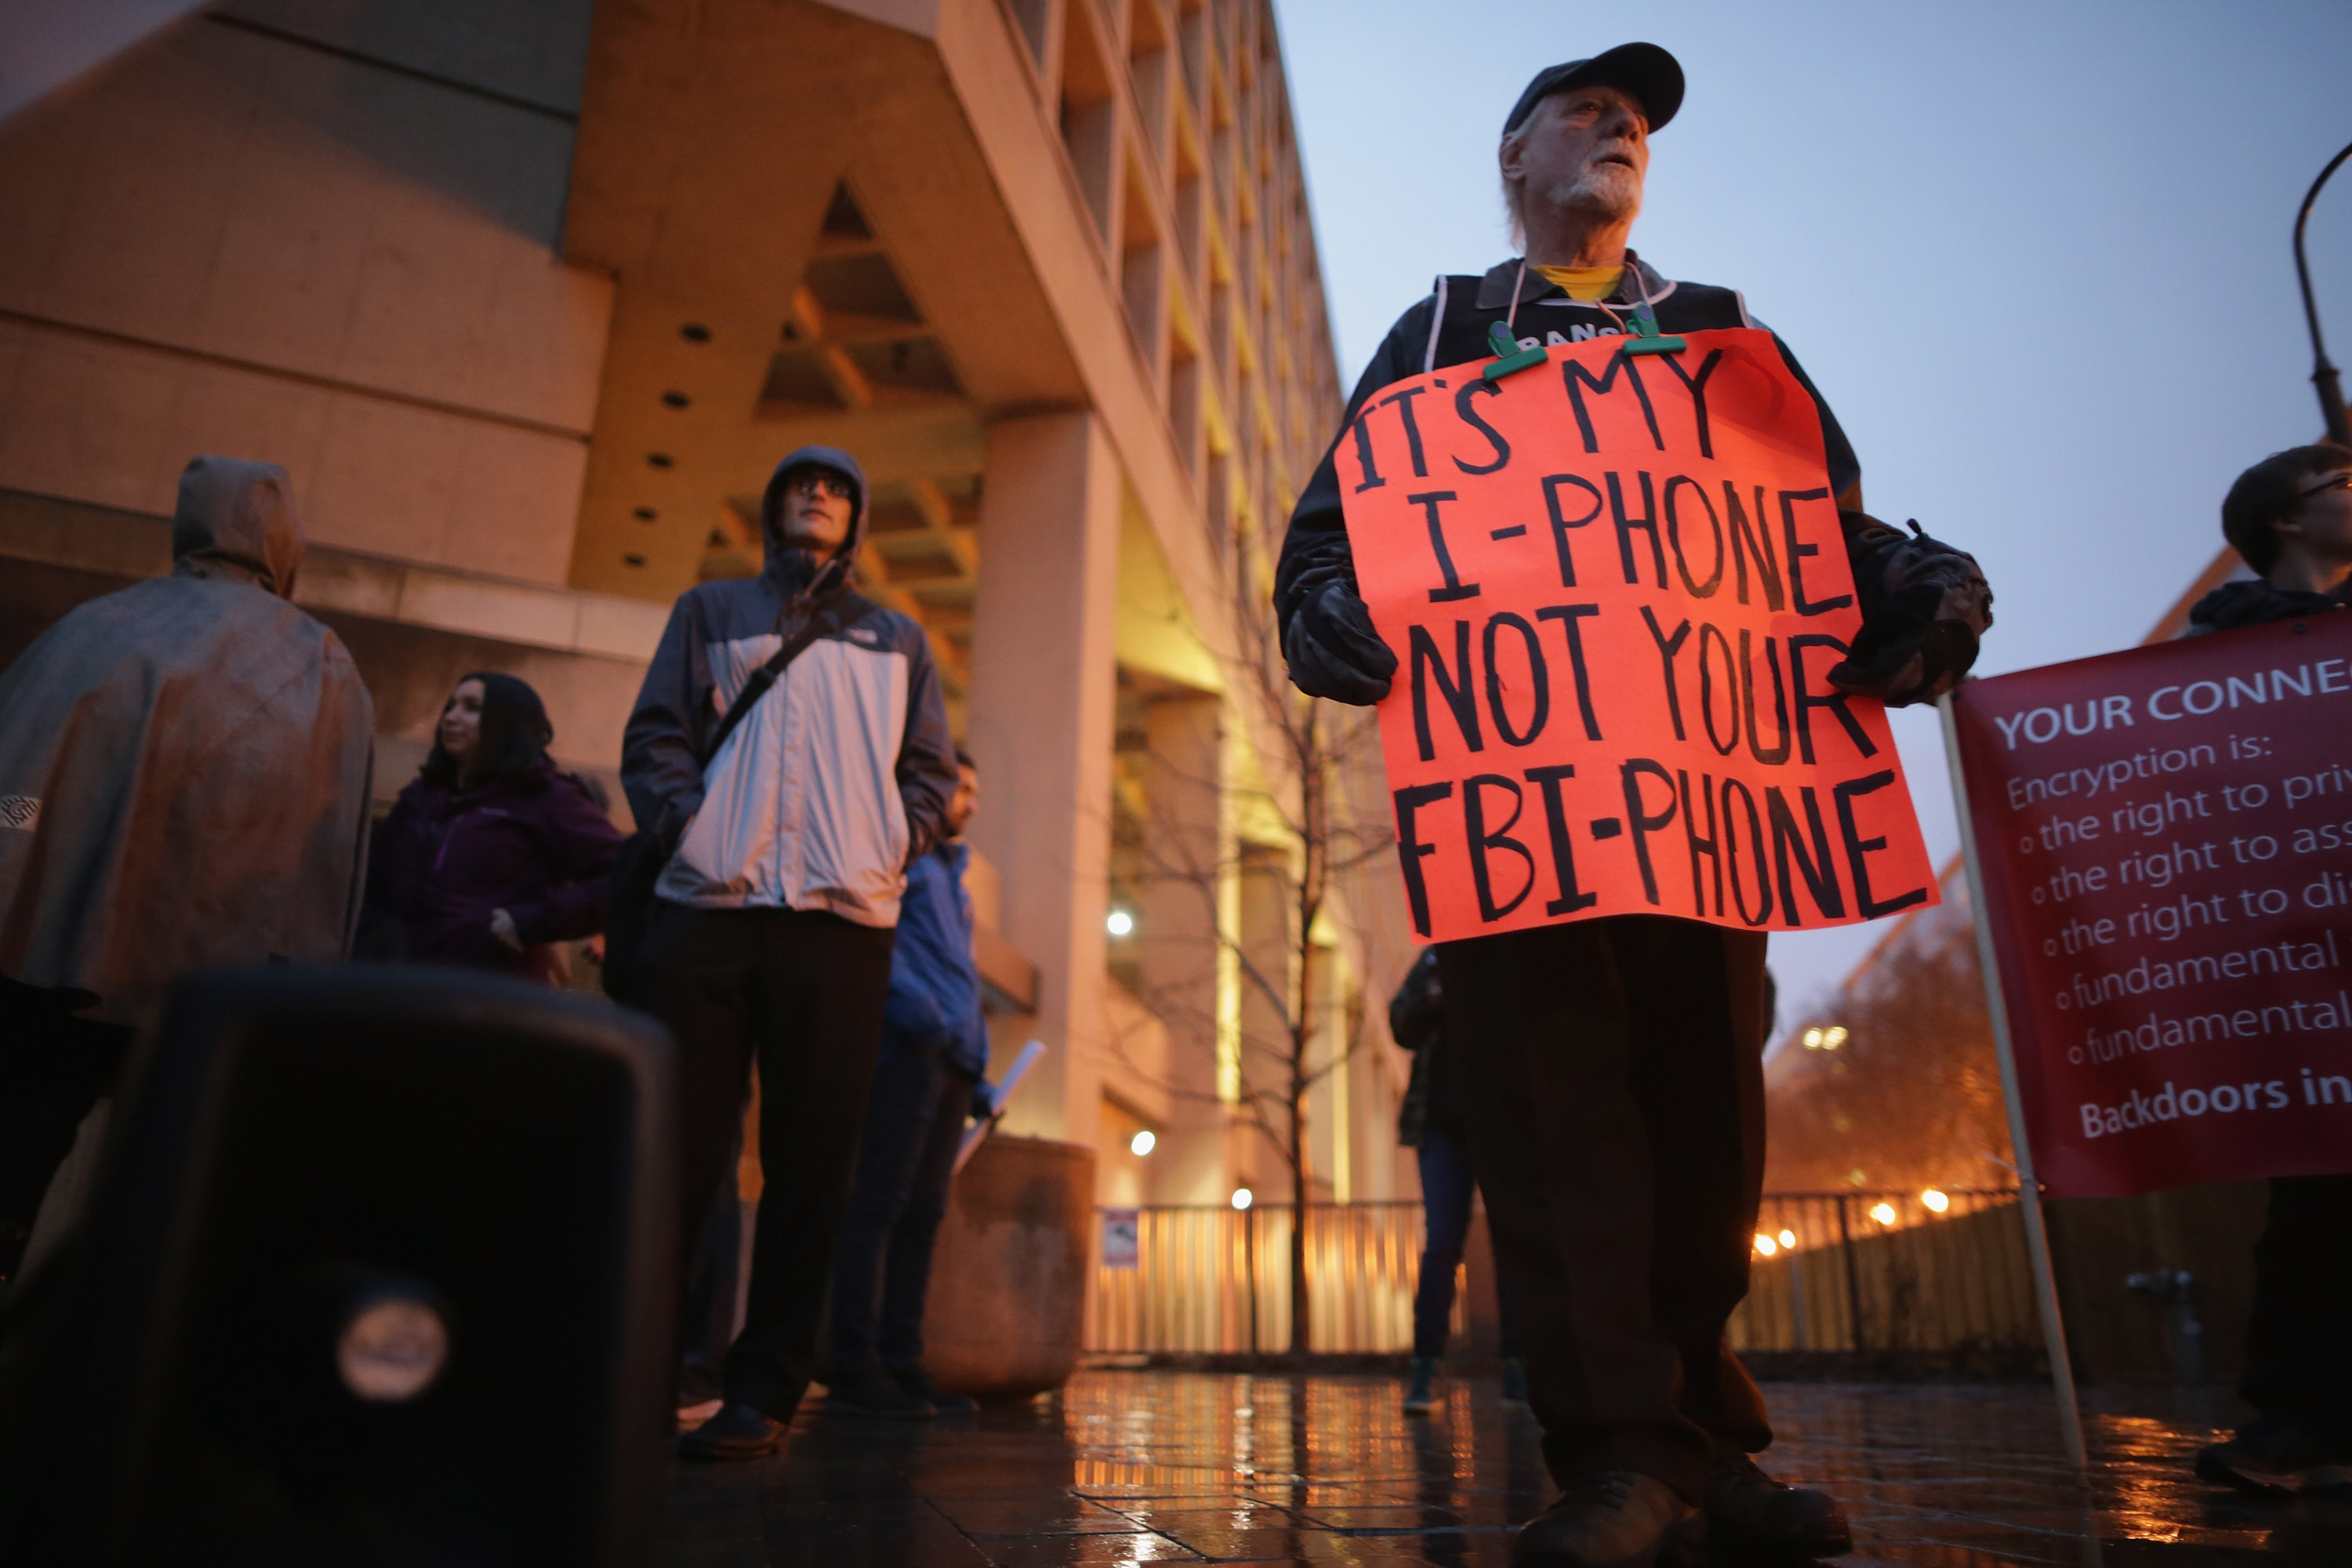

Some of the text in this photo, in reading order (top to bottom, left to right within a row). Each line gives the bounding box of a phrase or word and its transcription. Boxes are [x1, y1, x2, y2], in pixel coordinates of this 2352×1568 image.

[1352, 349, 1722, 493] IT'S MY
[1410, 604, 1878, 766] NOT YOUR
[1994, 658, 2352, 750] YOUR CONNE
[2006, 735, 2272, 811] Encryption is:
[1393, 757, 1928, 937] FBI-PHONE
[2040, 815, 2100, 850] the
[2112, 790, 2212, 836] right
[2222, 782, 2269, 811] to
[2050, 866, 2107, 902] the
[2120, 840, 2220, 887] right
[2230, 835, 2278, 863] to
[2061, 872, 2352, 955] the right to di
[2073, 929, 2339, 1008] fundamental
[2086, 990, 2352, 1065] fundamental
[2080, 1080, 2291, 1139] Backdoors
